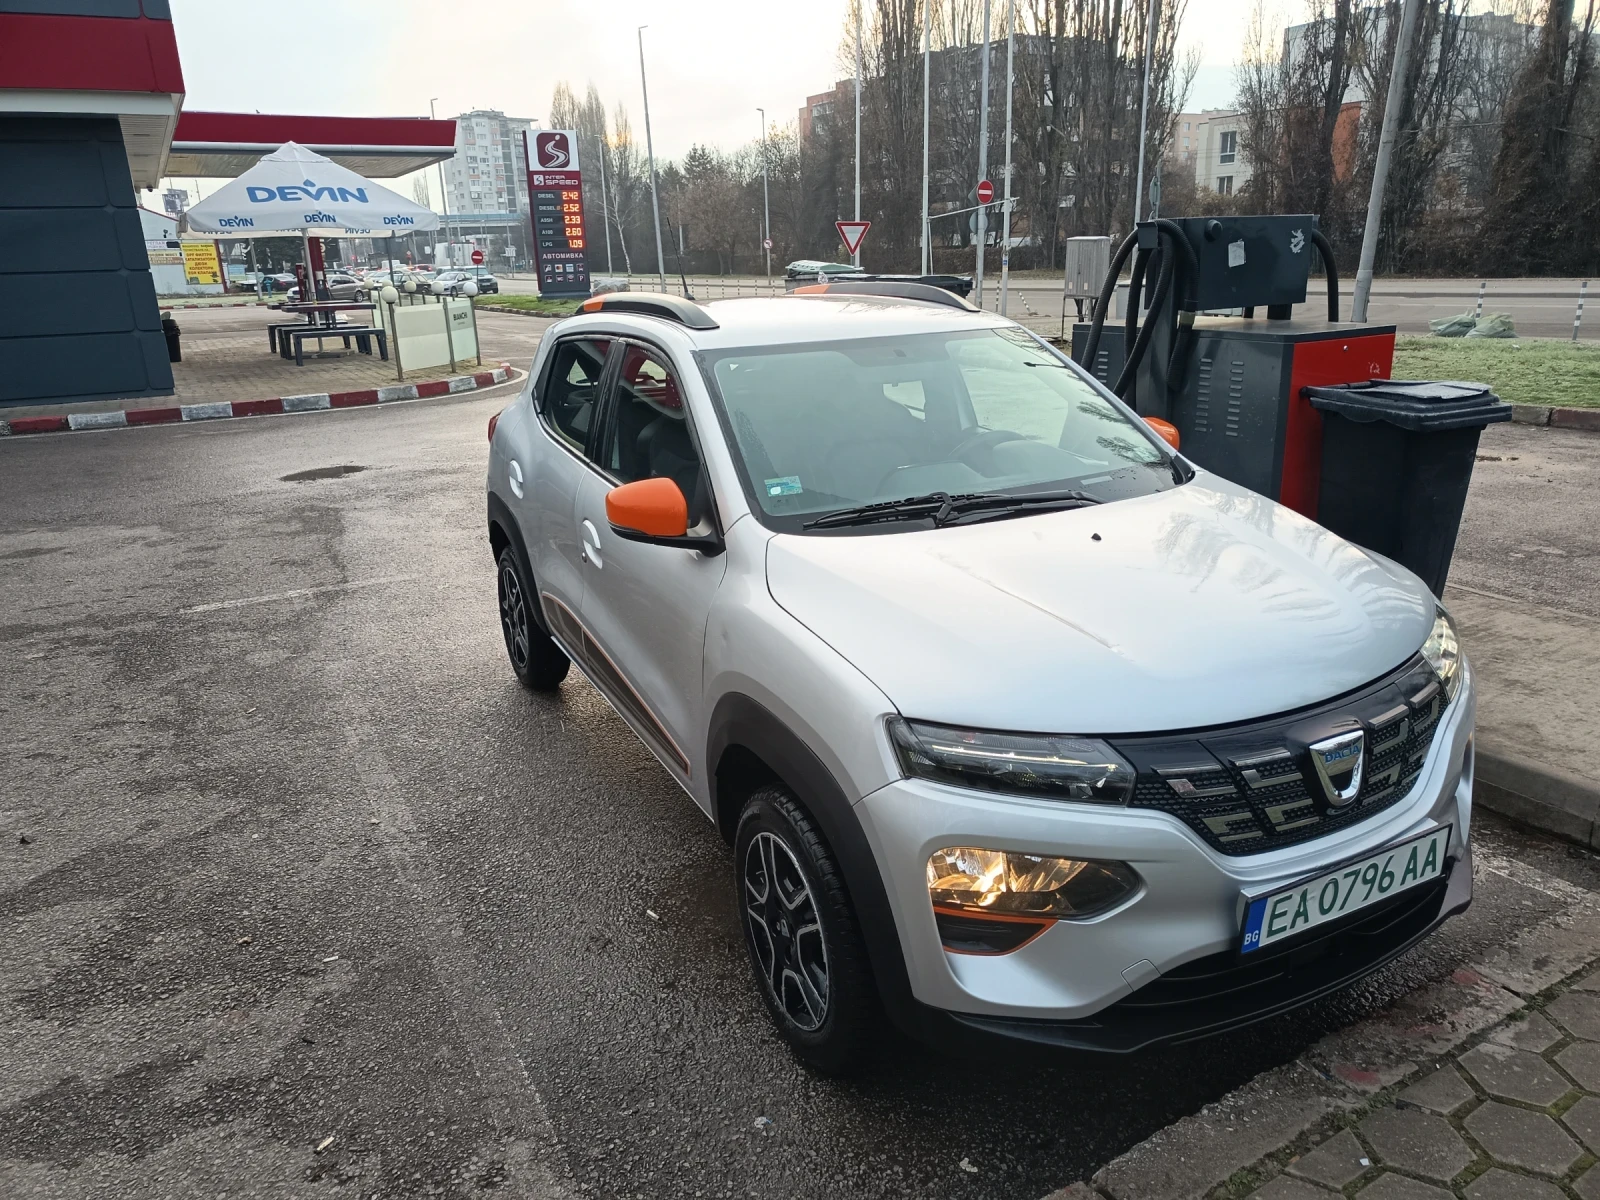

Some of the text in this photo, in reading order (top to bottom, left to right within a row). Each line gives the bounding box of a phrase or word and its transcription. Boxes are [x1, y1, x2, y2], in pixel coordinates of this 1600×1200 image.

[246, 179, 369, 203] DEVIN
[562, 191, 579, 200] 2.42
[563, 203, 580, 212] 2.52
[219, 216, 254, 227] DEVIN
[304, 211, 337, 223] DEVIN
[383, 214, 414, 225] DEVIN
[564, 215, 581, 224] 2.33
[565, 227, 582, 236] 2.60
[568, 239, 583, 248] 1.09
[542, 252, 584, 260] АВТОМИВКА
[1325, 745, 1360, 763] DACIA
[1266, 838, 1438, 939] EA 0796 AA
[1244, 930, 1259, 945] BG
